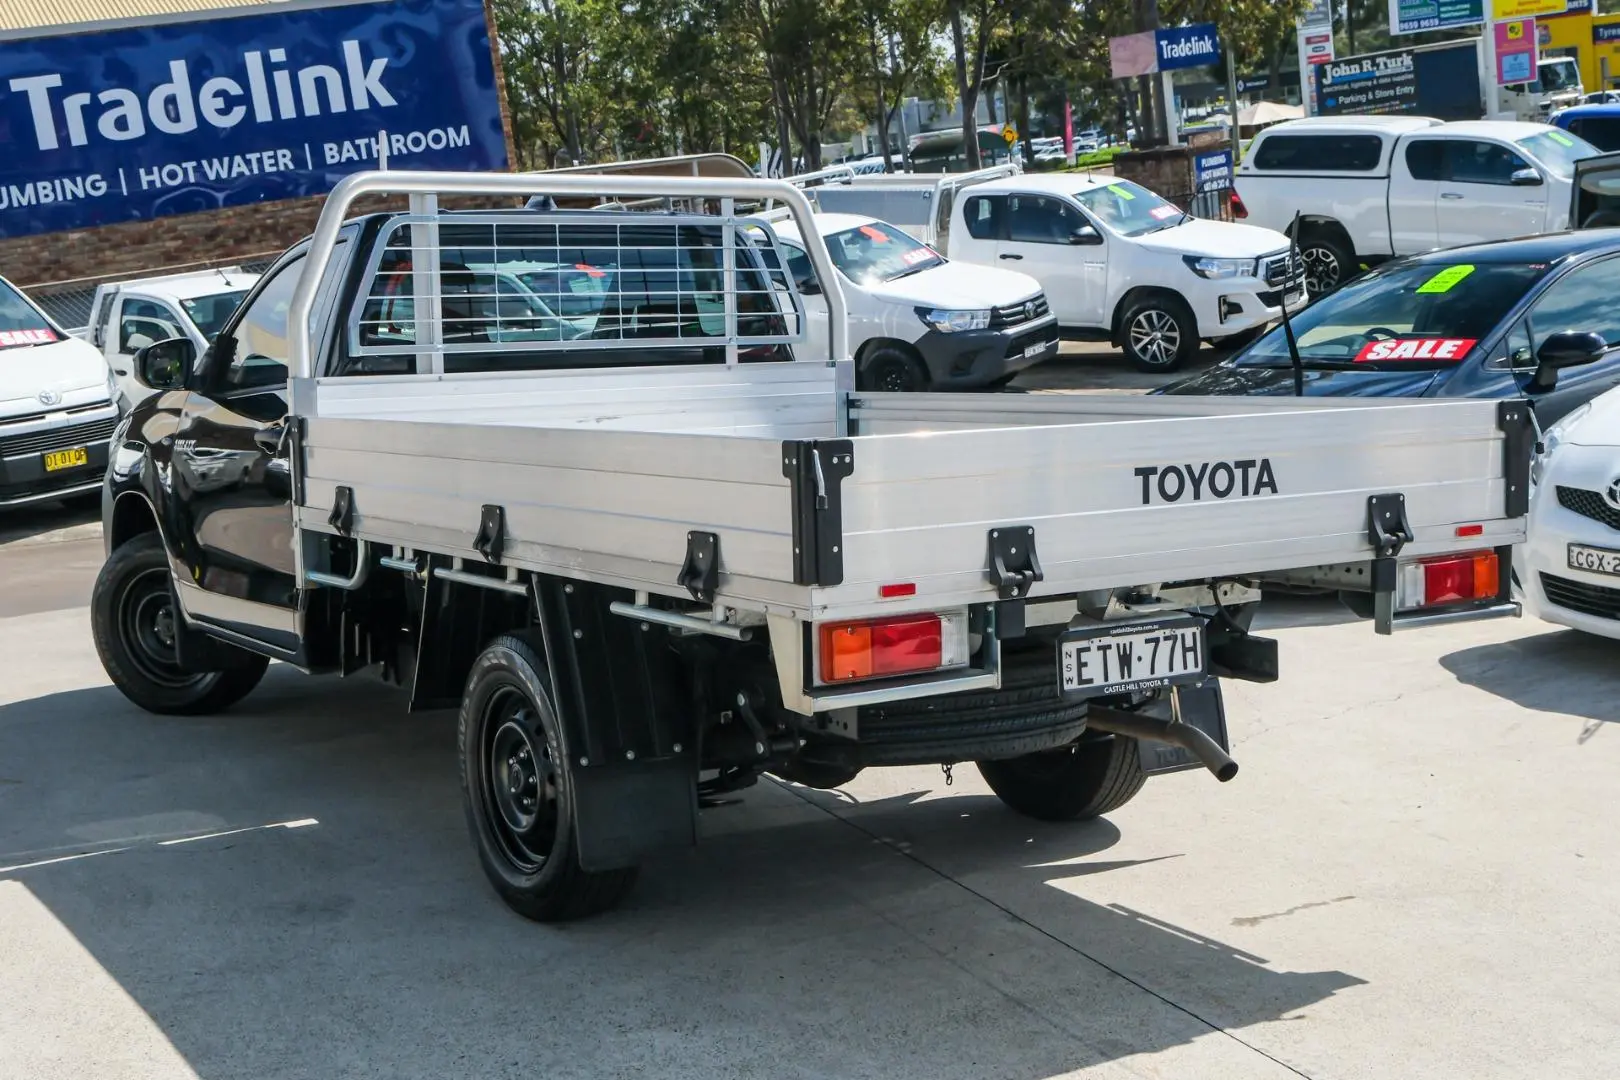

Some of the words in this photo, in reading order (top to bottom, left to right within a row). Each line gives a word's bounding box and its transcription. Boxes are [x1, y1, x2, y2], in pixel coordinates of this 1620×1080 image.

[1160, 34, 1214, 60] Tradelink
[1322, 62, 1360, 85] John
[1376, 53, 1413, 69] Turk
[10, 40, 398, 151] Tradelink
[1338, 93, 1367, 105] Parking
[1367, 91, 1373, 100] &
[1374, 88, 1395, 99] Store
[1395, 85, 1415, 95] Entry
[139, 161, 197, 190] HOT
[200, 148, 294, 181] WATER
[323, 125, 471, 165] BATHROOM
[1, 330, 51, 345] SALE
[1366, 339, 1461, 360] SALE
[1134, 458, 1278, 504] TOYOTA
[1104, 683, 1126, 694] CASTLE
[1126, 681, 1138, 692] HILL
[1139, 679, 1162, 690] TOYOTA
